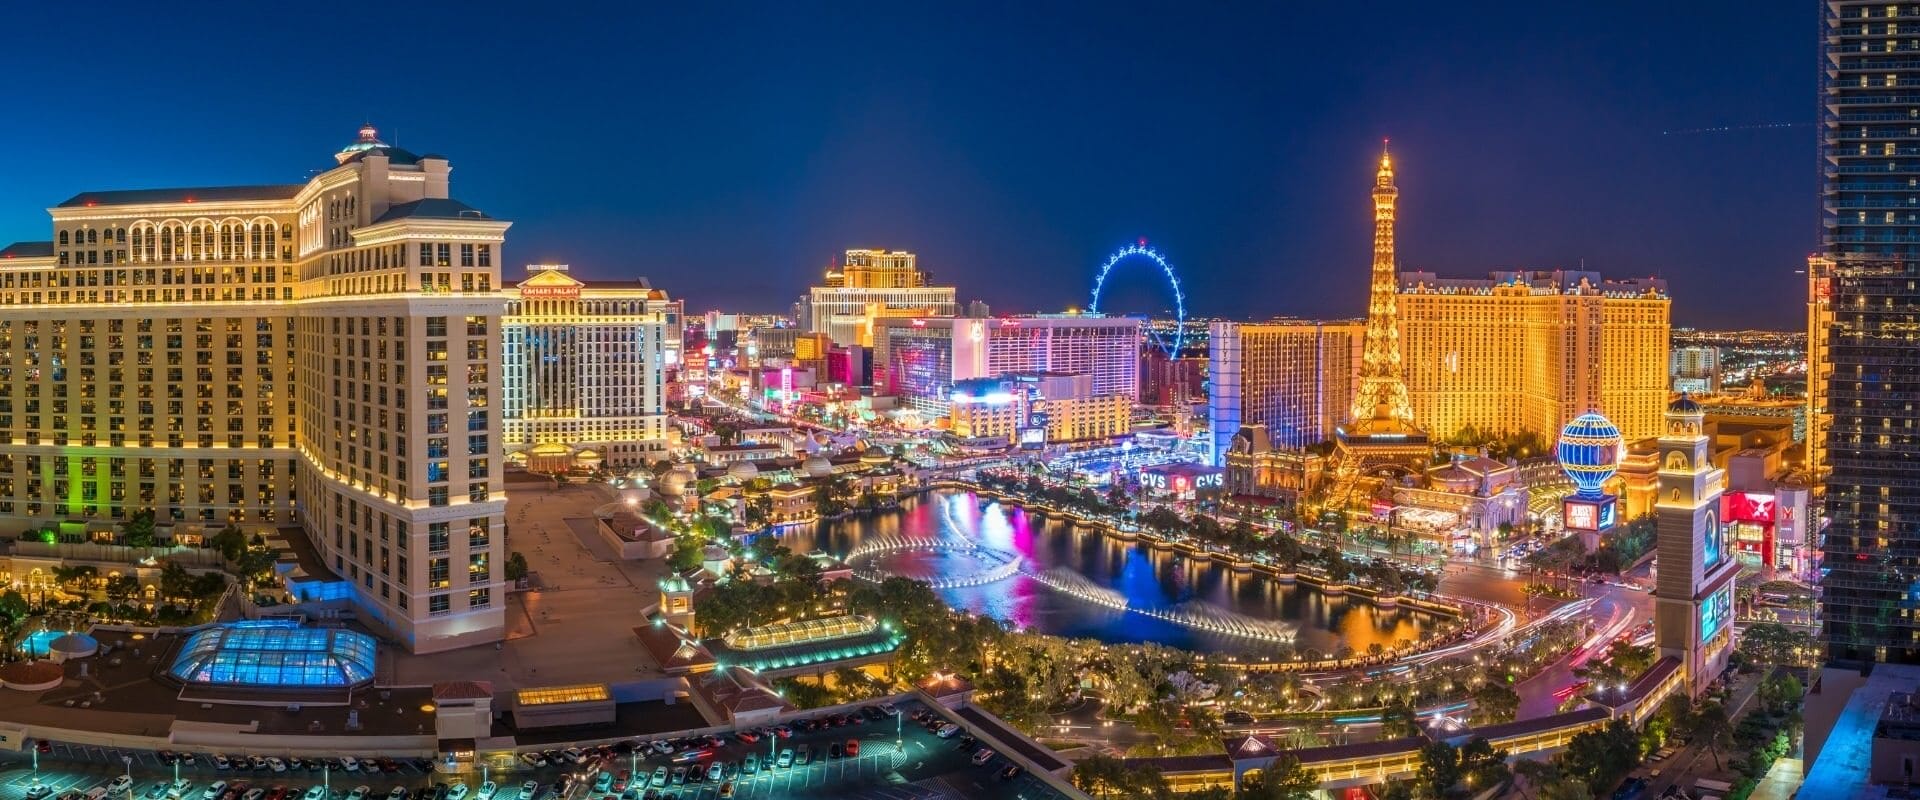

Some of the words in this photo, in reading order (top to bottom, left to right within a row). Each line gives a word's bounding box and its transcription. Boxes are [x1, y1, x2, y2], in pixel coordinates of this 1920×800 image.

[1140, 472, 1166, 489] CVS
[1196, 473, 1223, 488] CVS
[1571, 505, 1593, 517] JERSEY
